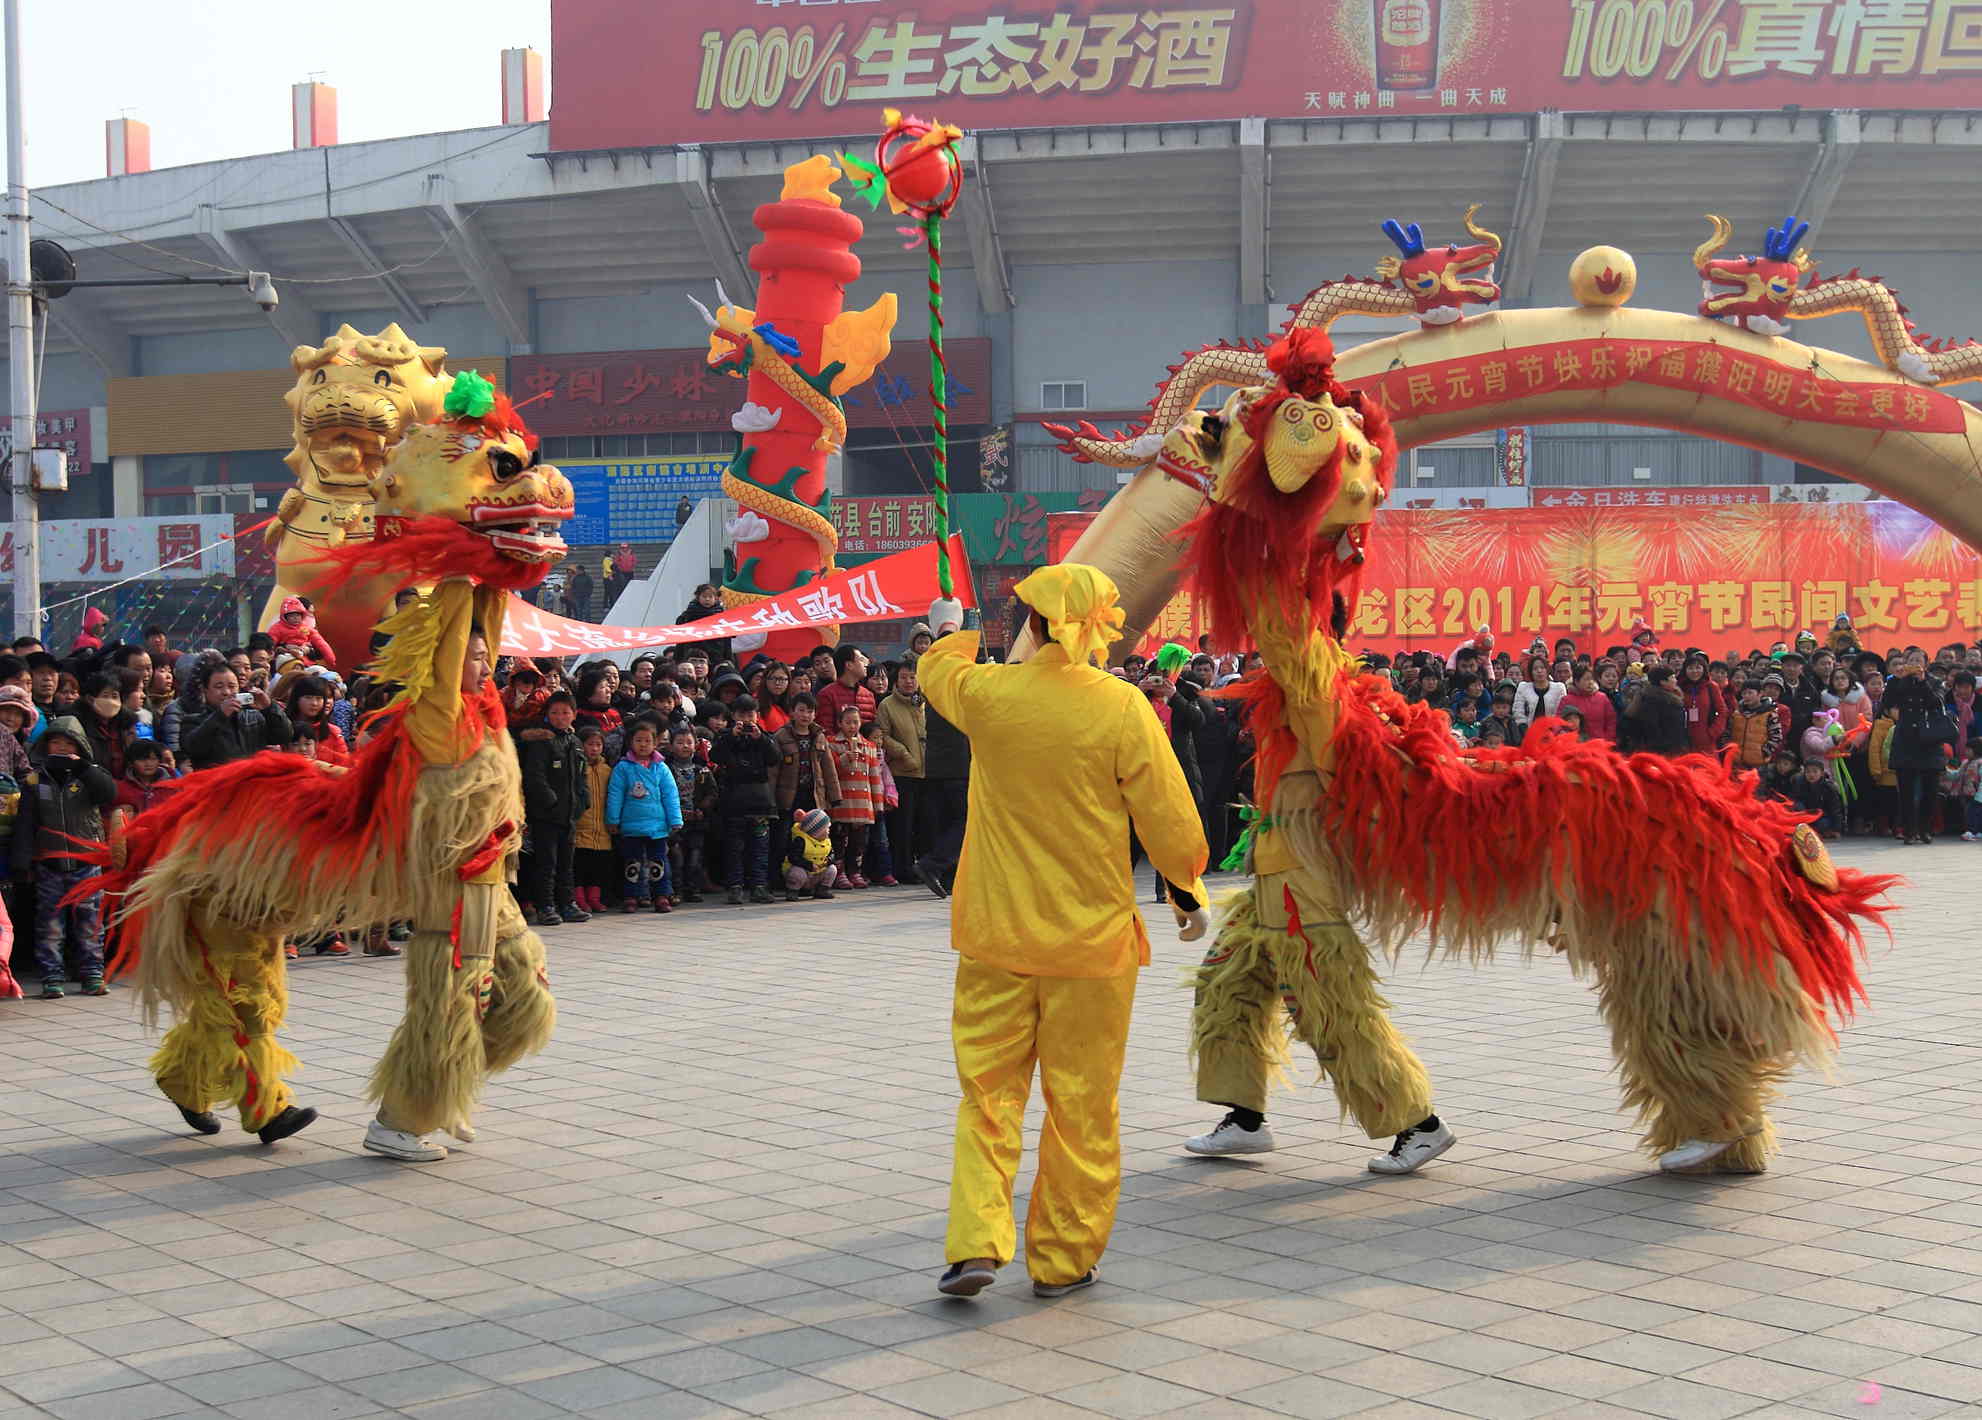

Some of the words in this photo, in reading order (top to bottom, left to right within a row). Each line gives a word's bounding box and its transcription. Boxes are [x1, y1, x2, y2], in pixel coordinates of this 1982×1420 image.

[696, 8, 1234, 110] 100%生态好酒
[868, 501, 901, 537] 台前
